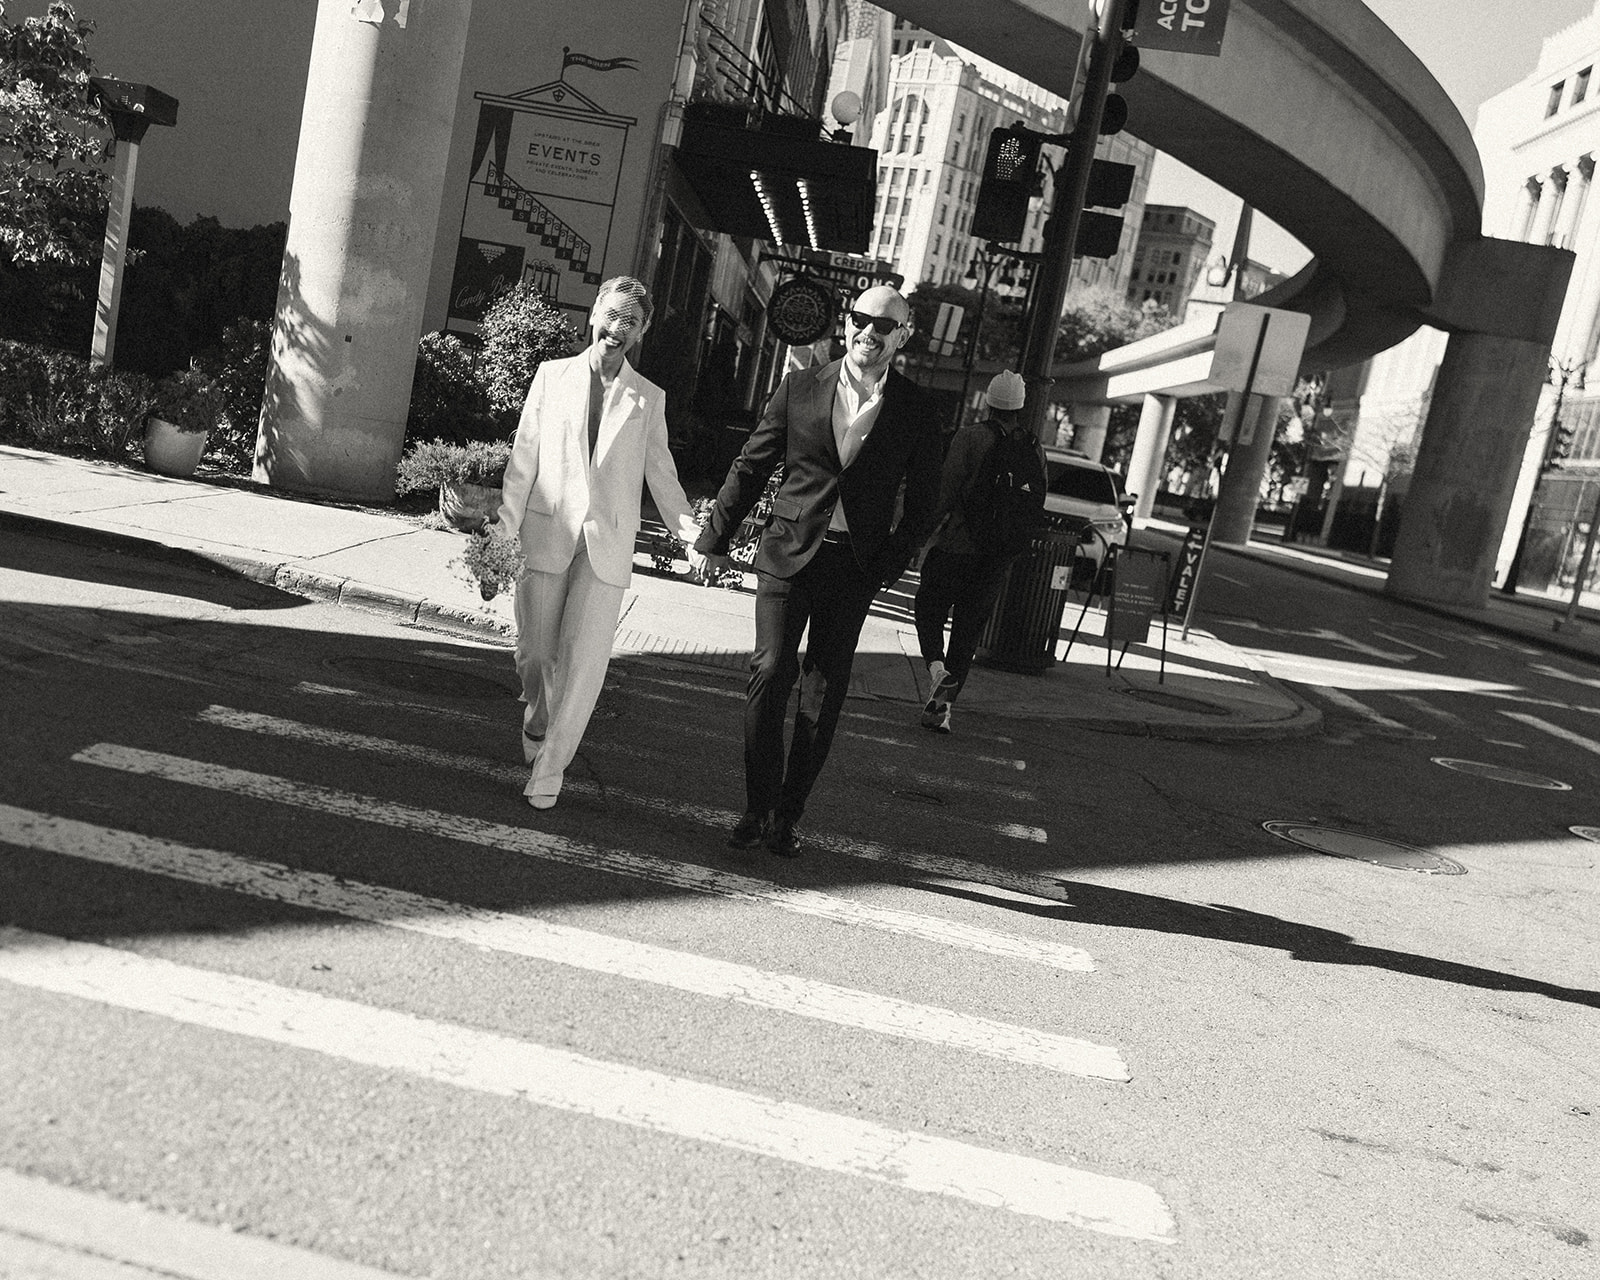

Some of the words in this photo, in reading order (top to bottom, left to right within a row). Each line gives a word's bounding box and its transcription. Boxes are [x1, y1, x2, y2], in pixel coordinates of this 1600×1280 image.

[1157, 0, 1177, 31] AC
[528, 142, 601, 166] EVENTS
[833, 256, 876, 272] CREDIT
[455, 286, 486, 309] Candy
[1174, 552, 1198, 612] VALET
